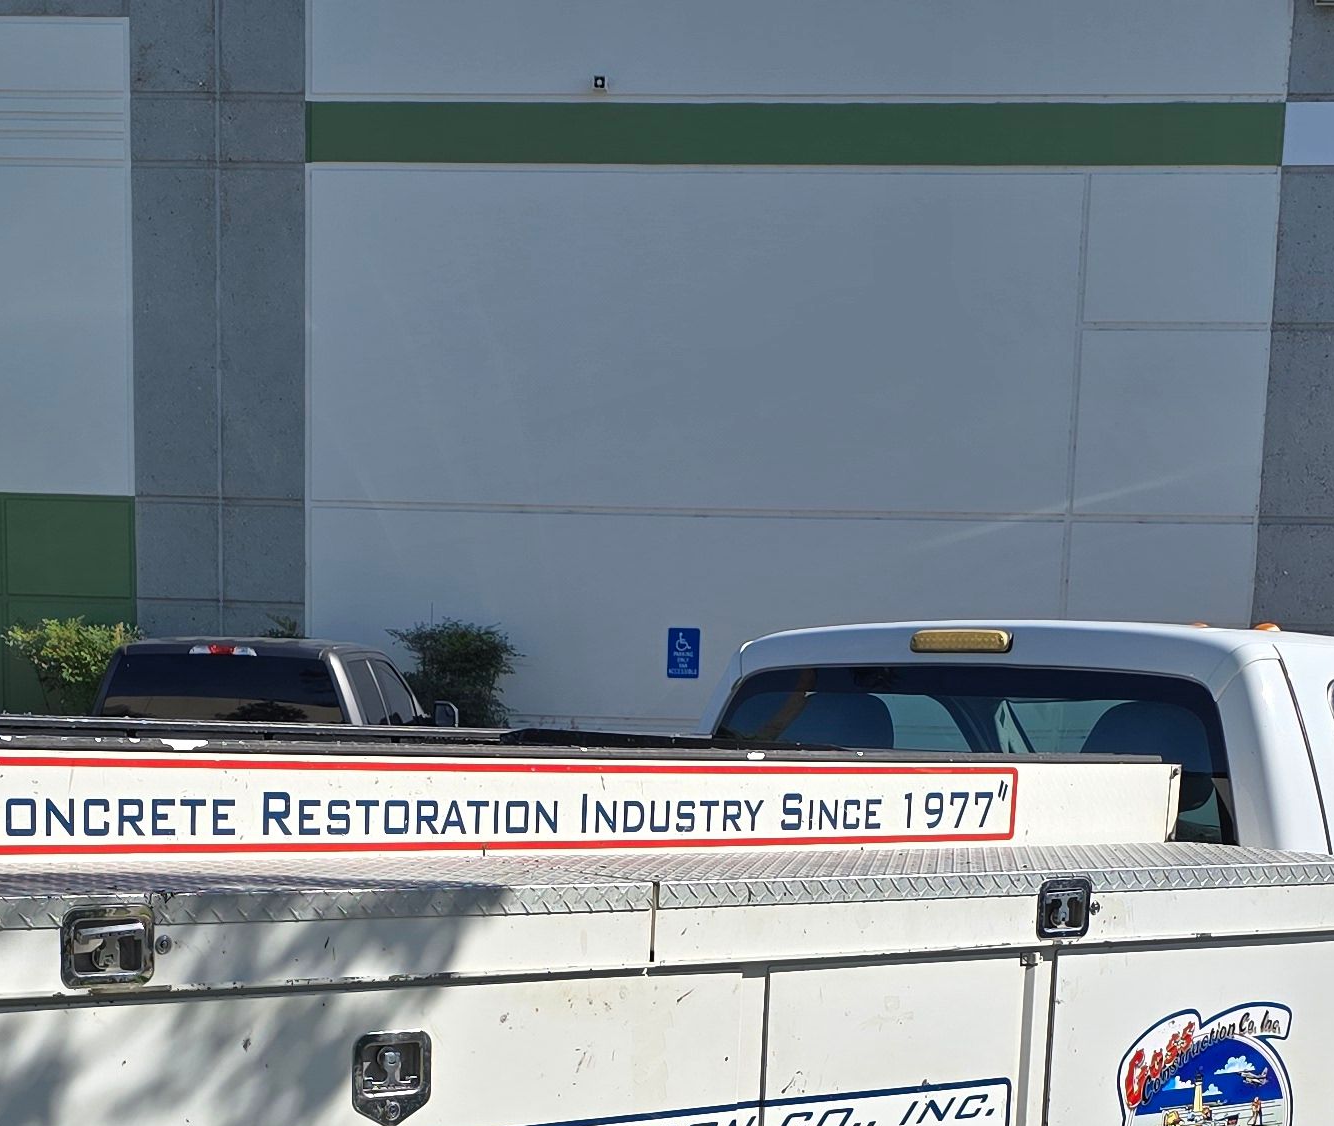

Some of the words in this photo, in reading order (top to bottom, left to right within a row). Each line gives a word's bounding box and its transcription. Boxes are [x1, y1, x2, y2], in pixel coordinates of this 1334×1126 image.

[263, 790, 558, 836] RESTORATION
[580, 790, 765, 835] INDUSTRY
[780, 792, 883, 831] SINCE
[902, 780, 1009, 829] 1977"
[898, 1093, 996, 1126] INC.
